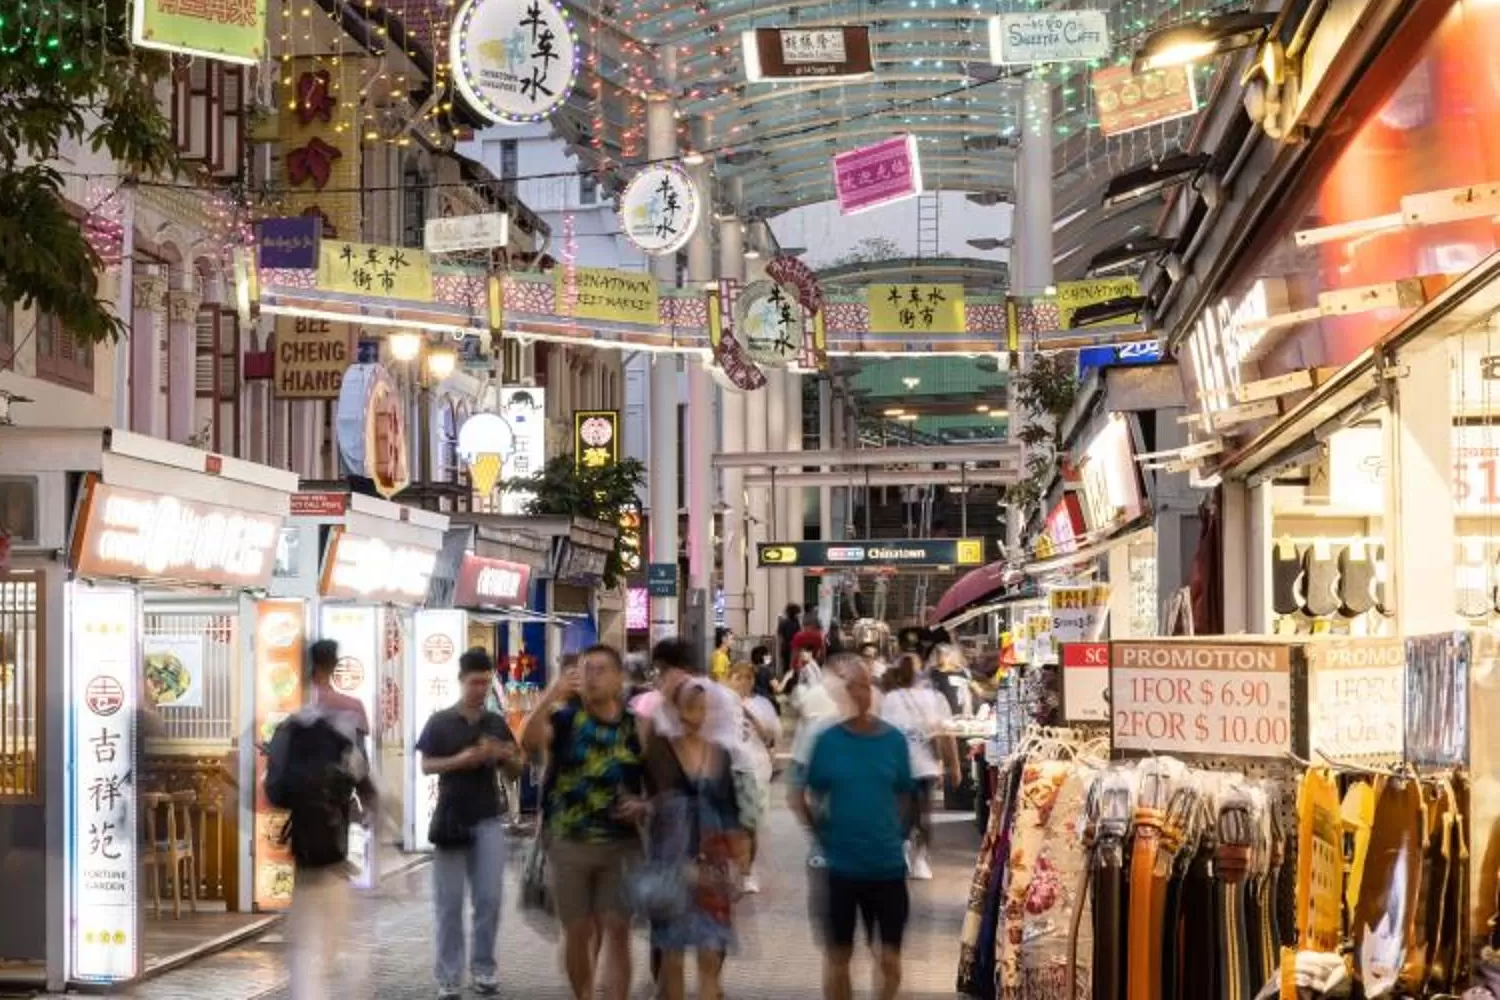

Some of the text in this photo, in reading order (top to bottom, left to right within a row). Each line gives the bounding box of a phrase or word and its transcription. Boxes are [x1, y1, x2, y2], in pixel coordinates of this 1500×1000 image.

[295, 315, 331, 333] BEE
[280, 340, 345, 363] CHENG
[281, 370, 342, 391] HIANG
[867, 548, 926, 559] Chinatown
[1122, 647, 1276, 669] PROMOTION
[1130, 676, 1270, 709] 1FOR $ 6.90
[1116, 710, 1288, 745] 2FOR $ 10.00
